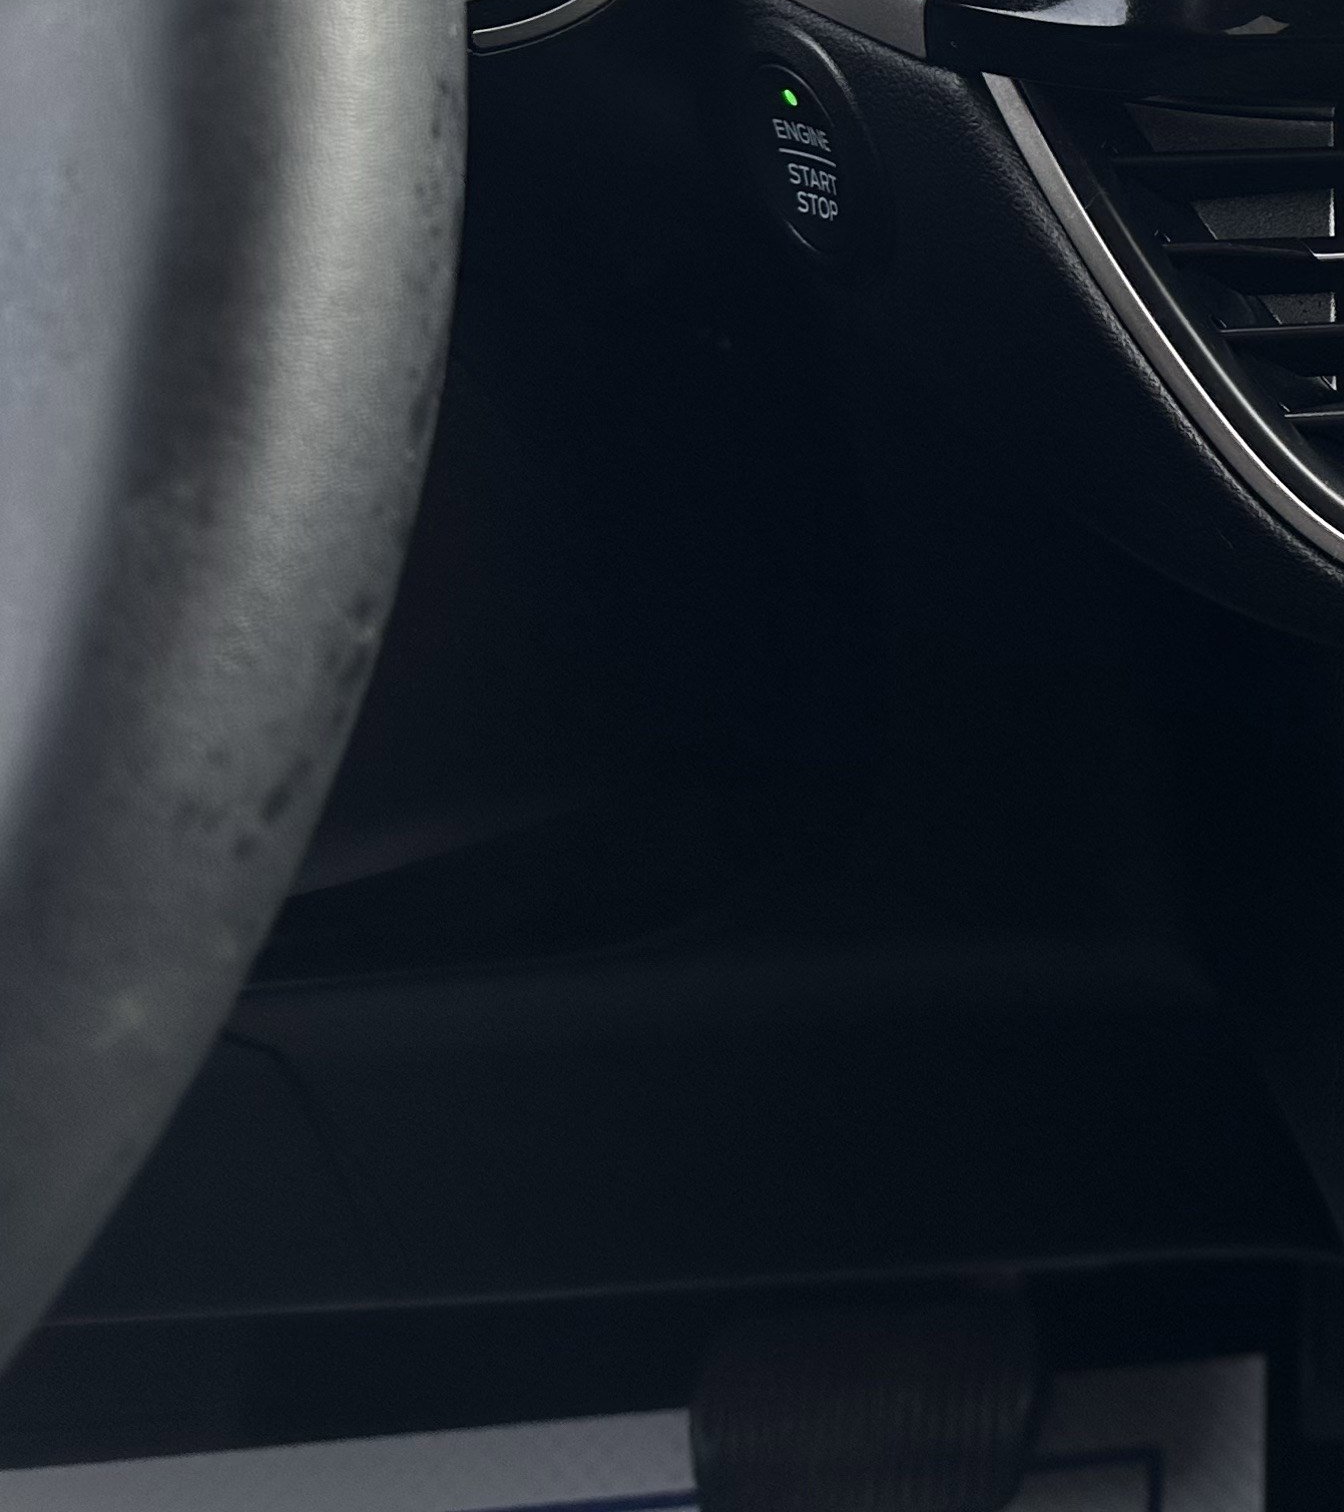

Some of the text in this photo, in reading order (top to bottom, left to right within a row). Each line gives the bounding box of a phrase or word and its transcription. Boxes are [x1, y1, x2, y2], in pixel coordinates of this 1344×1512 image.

[772, 118, 832, 152] ENGINE
[787, 163, 837, 196] START
[797, 191, 839, 221] STOP
